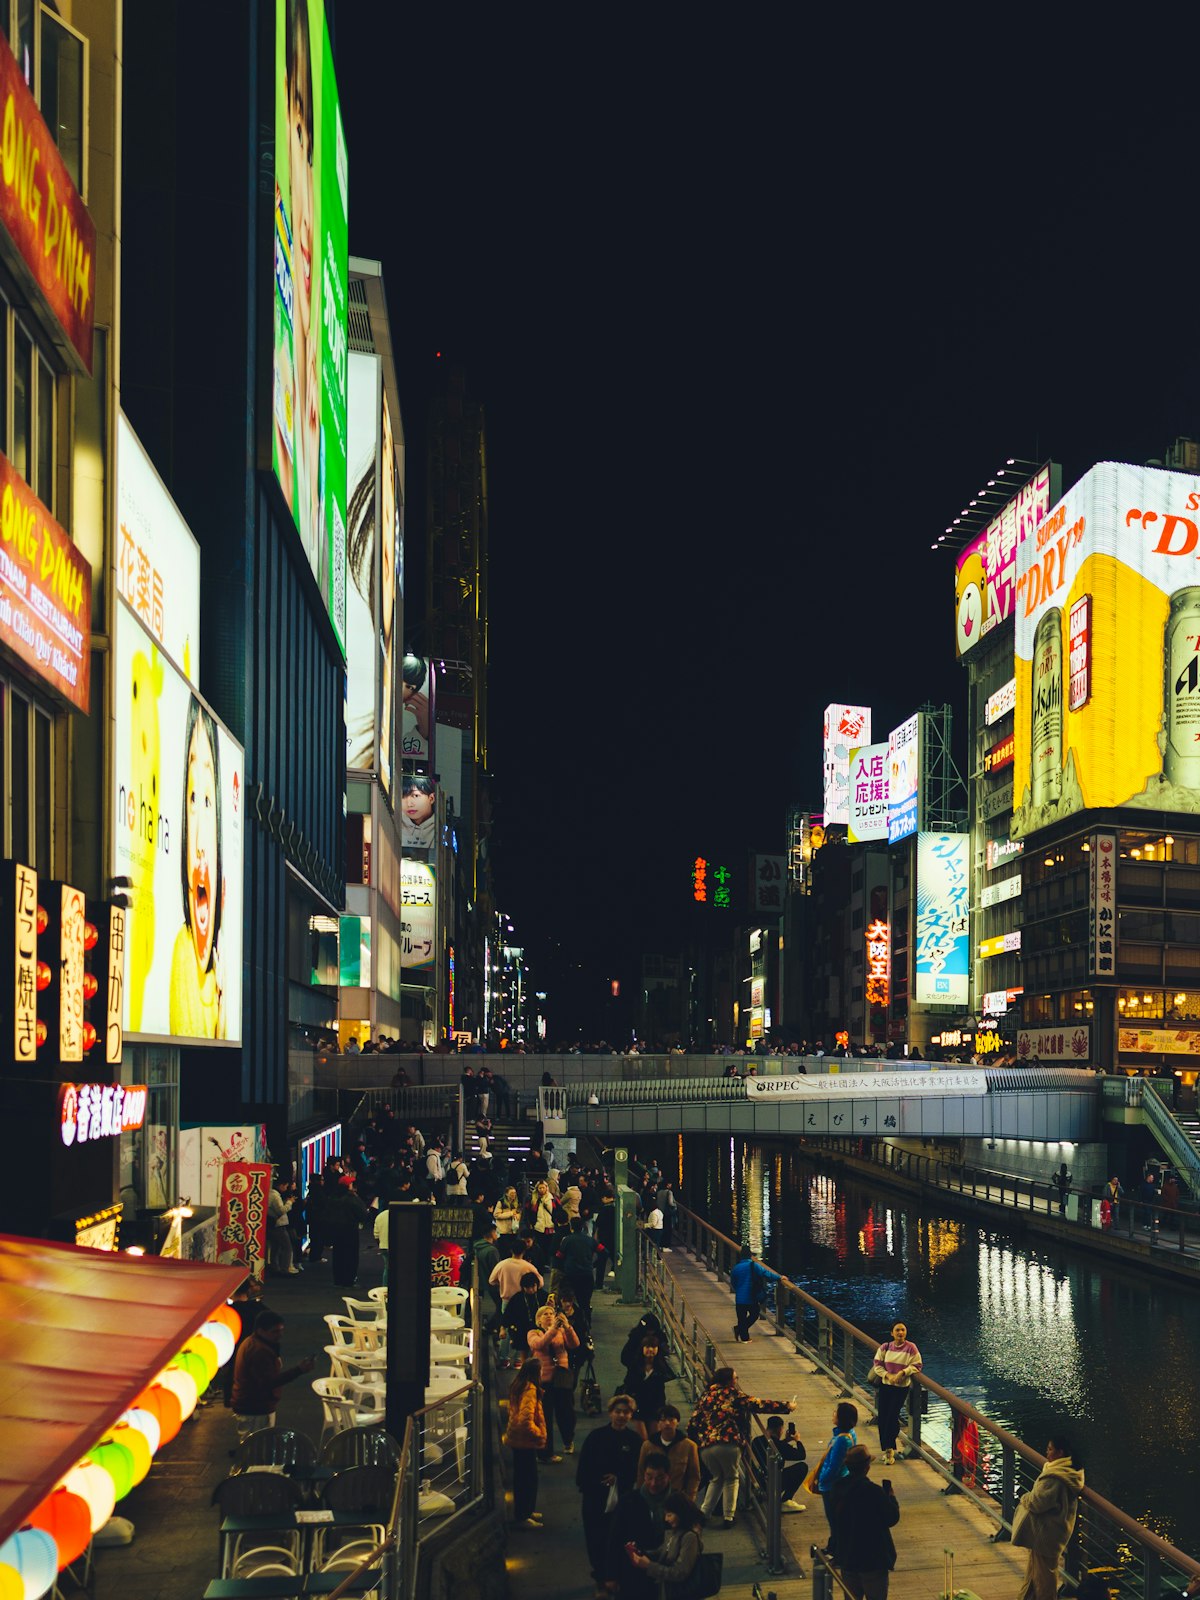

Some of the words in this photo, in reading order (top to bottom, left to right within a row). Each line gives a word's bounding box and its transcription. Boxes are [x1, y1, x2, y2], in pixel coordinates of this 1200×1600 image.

[0, 94, 42, 232] ONG
[44, 172, 91, 321] DINH
[0, 484, 38, 571] ONG
[40, 526, 84, 617] DINH
[986, 466, 1049, 582] 家事代行
[1036, 504, 1067, 553] SUPER
[30, 583, 83, 651] RESTAURANT
[401, 890, 431, 907] デュース
[18, 870, 35, 1057] たこ焼き
[108, 912, 124, 1060] 串かつ
[807, 1113, 897, 1129] えびす橋
[808, 1078, 868, 1090] 一般社団法人
[245, 1172, 266, 1276] TAKOYAKI
